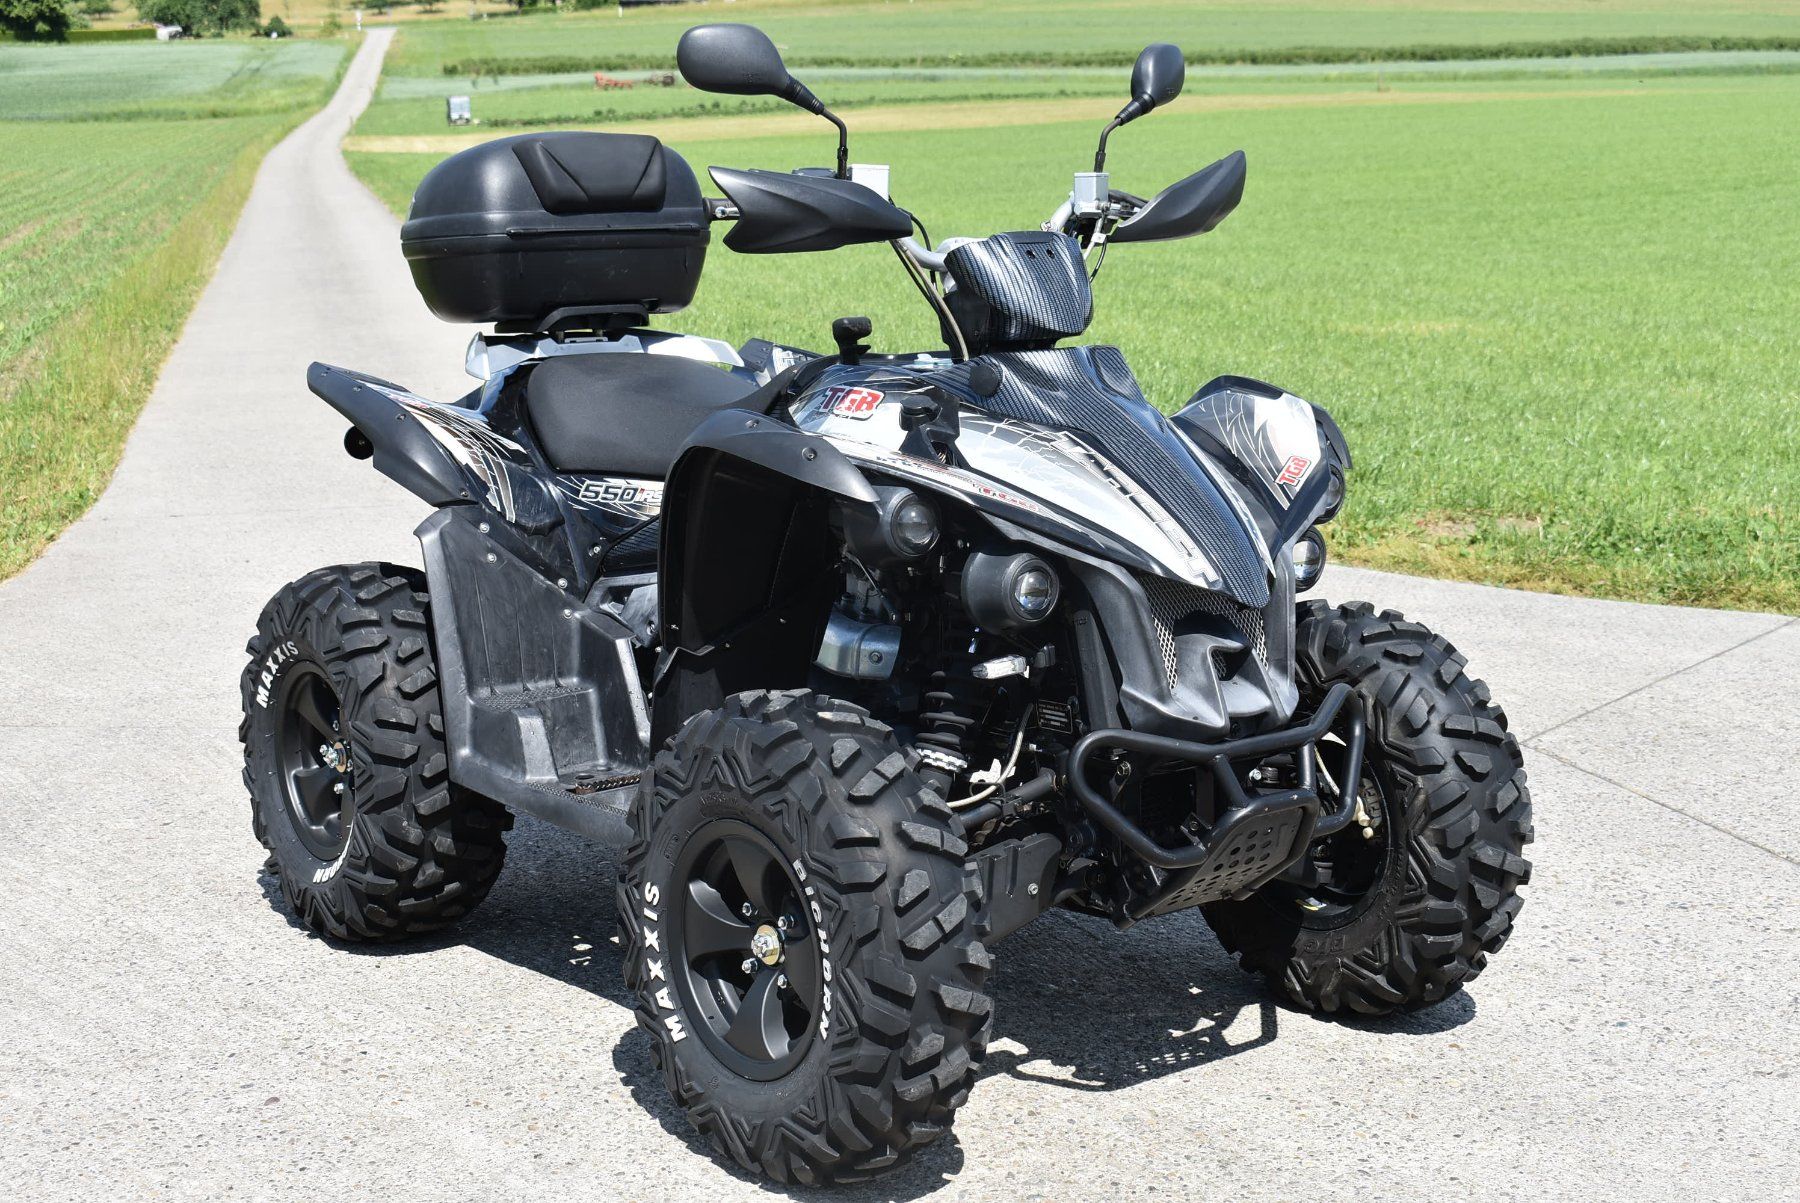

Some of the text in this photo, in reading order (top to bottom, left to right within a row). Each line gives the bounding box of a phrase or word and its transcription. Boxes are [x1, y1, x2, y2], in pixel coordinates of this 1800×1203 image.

[820, 386, 885, 417] TGB
[580, 481, 640, 504] 550
[1277, 456, 1309, 486] TGB
[256, 641, 299, 708] MAXXIS
[643, 881, 688, 1043] MAXXIS
[793, 859, 832, 1040] BIGHORN
